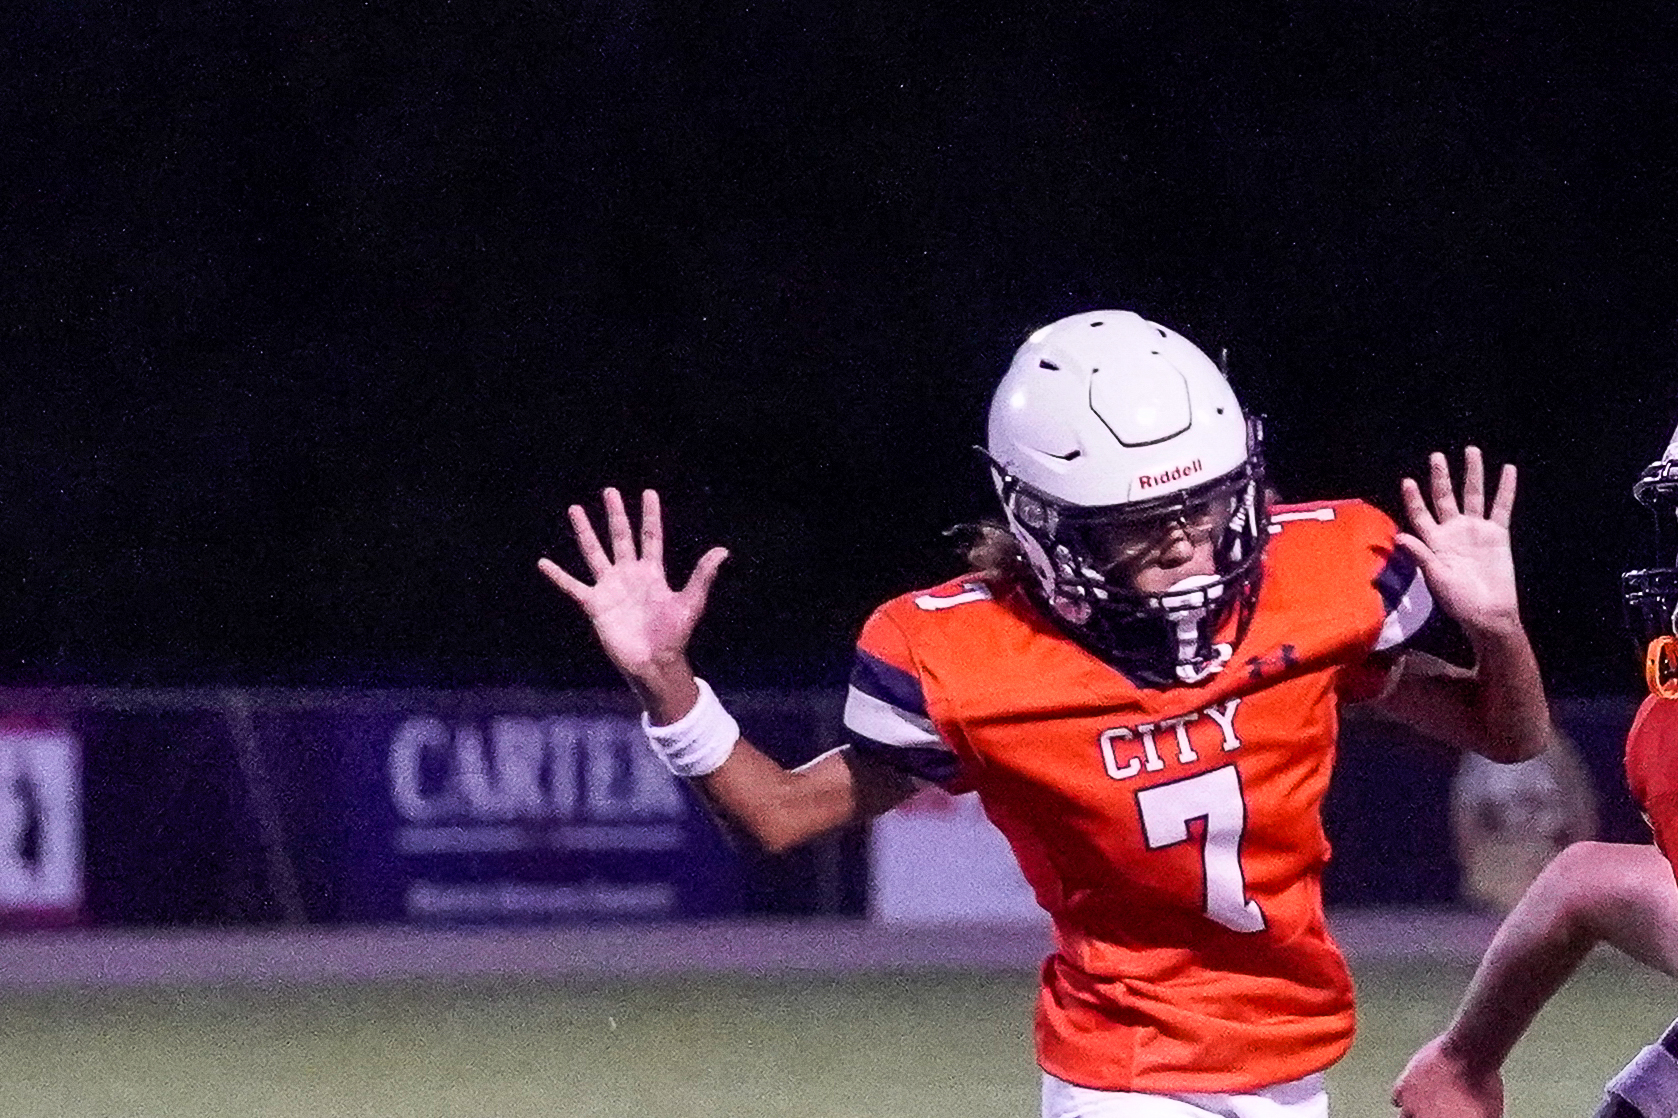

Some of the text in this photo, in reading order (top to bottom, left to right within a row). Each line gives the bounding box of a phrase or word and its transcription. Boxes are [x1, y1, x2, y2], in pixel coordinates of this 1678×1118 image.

[1138, 458, 1203, 490] Riddell
[1099, 697, 1242, 781] CITY
[1136, 764, 1268, 934] 7
